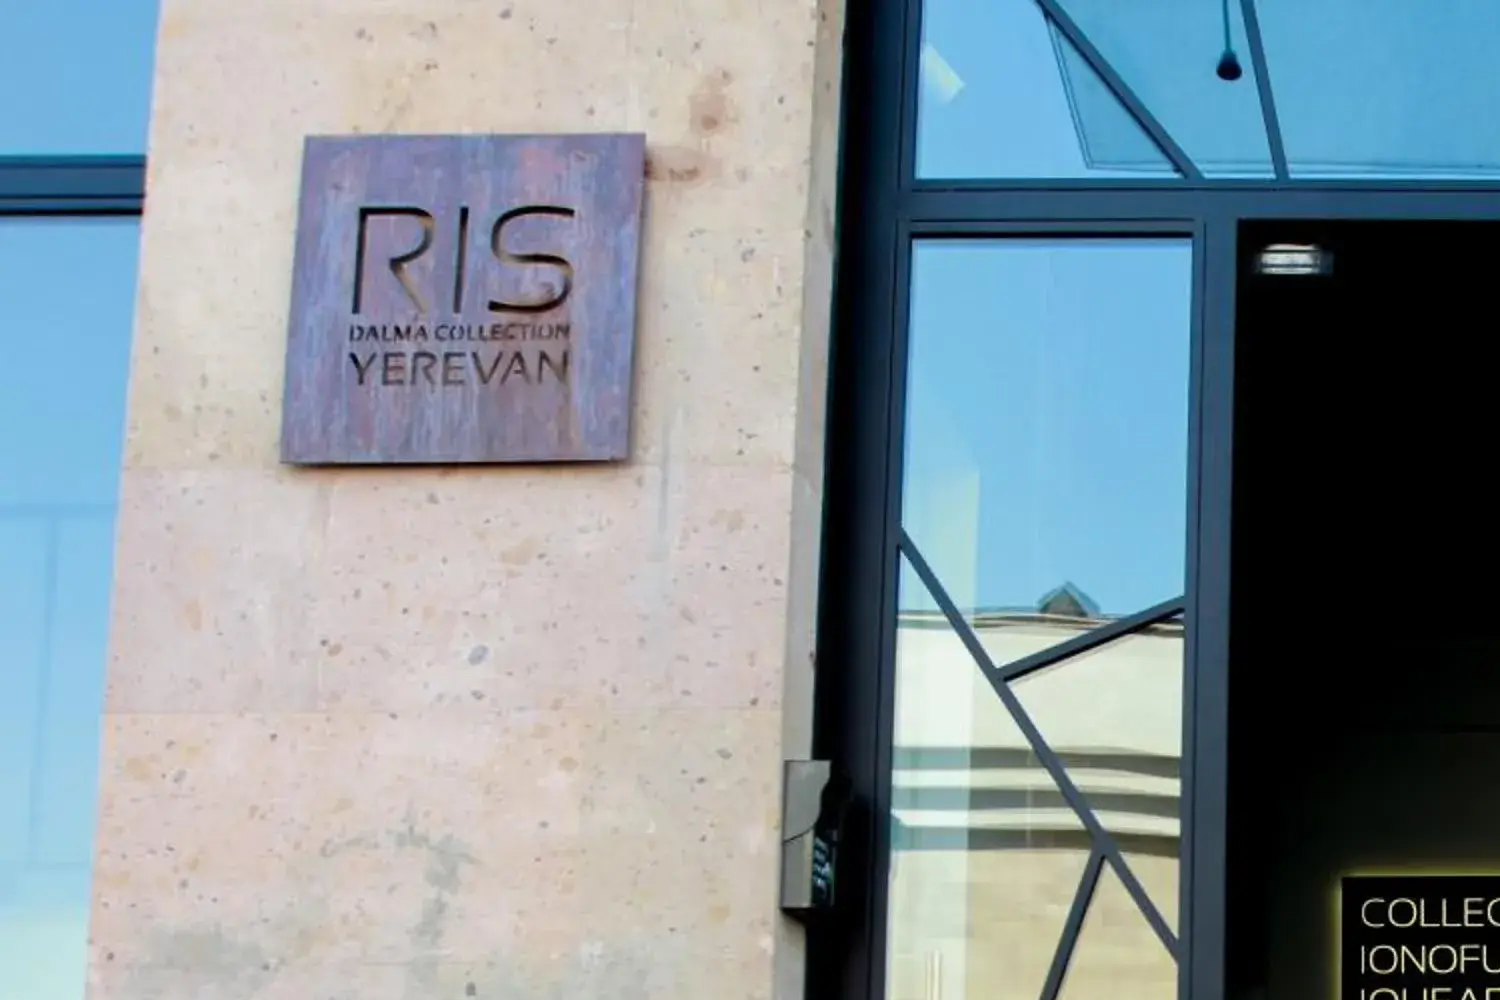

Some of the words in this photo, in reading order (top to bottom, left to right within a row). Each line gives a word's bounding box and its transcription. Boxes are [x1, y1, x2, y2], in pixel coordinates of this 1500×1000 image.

[351, 205, 575, 314] RIS
[349, 324, 427, 342] DALMA
[434, 323, 571, 342] COLLECTION
[349, 351, 573, 386] YEREVAN
